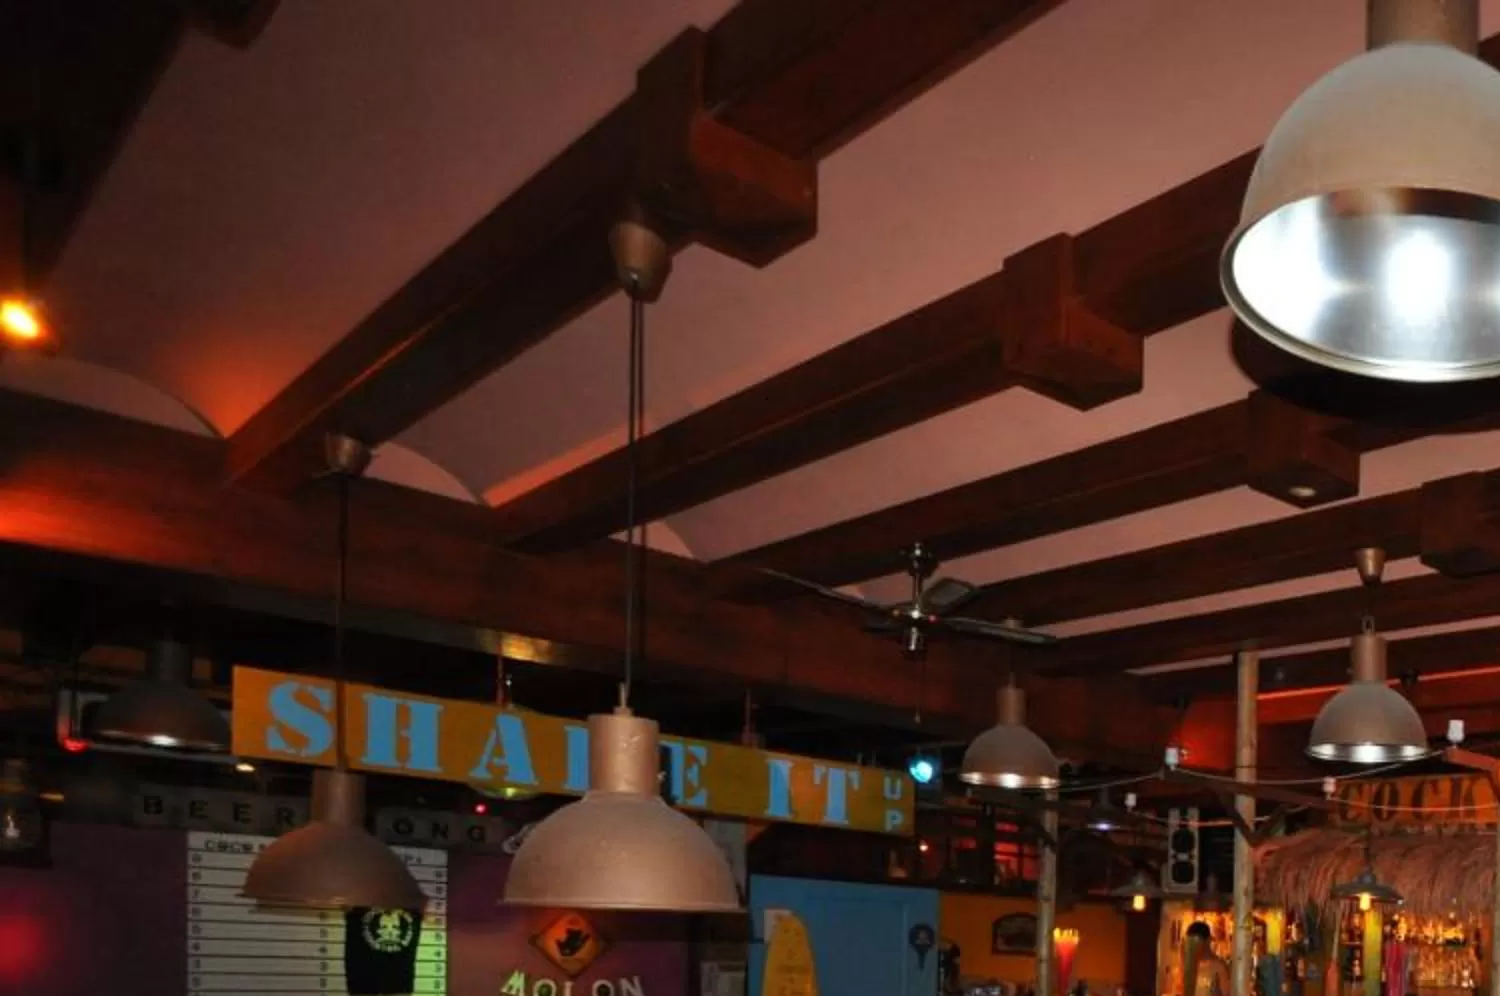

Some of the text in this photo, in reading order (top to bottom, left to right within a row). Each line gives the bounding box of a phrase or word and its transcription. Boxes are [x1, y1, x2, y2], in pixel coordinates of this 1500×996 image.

[142, 795, 486, 843] BEER ONG
[764, 758, 862, 825] IT
[882, 775, 902, 833] UP
